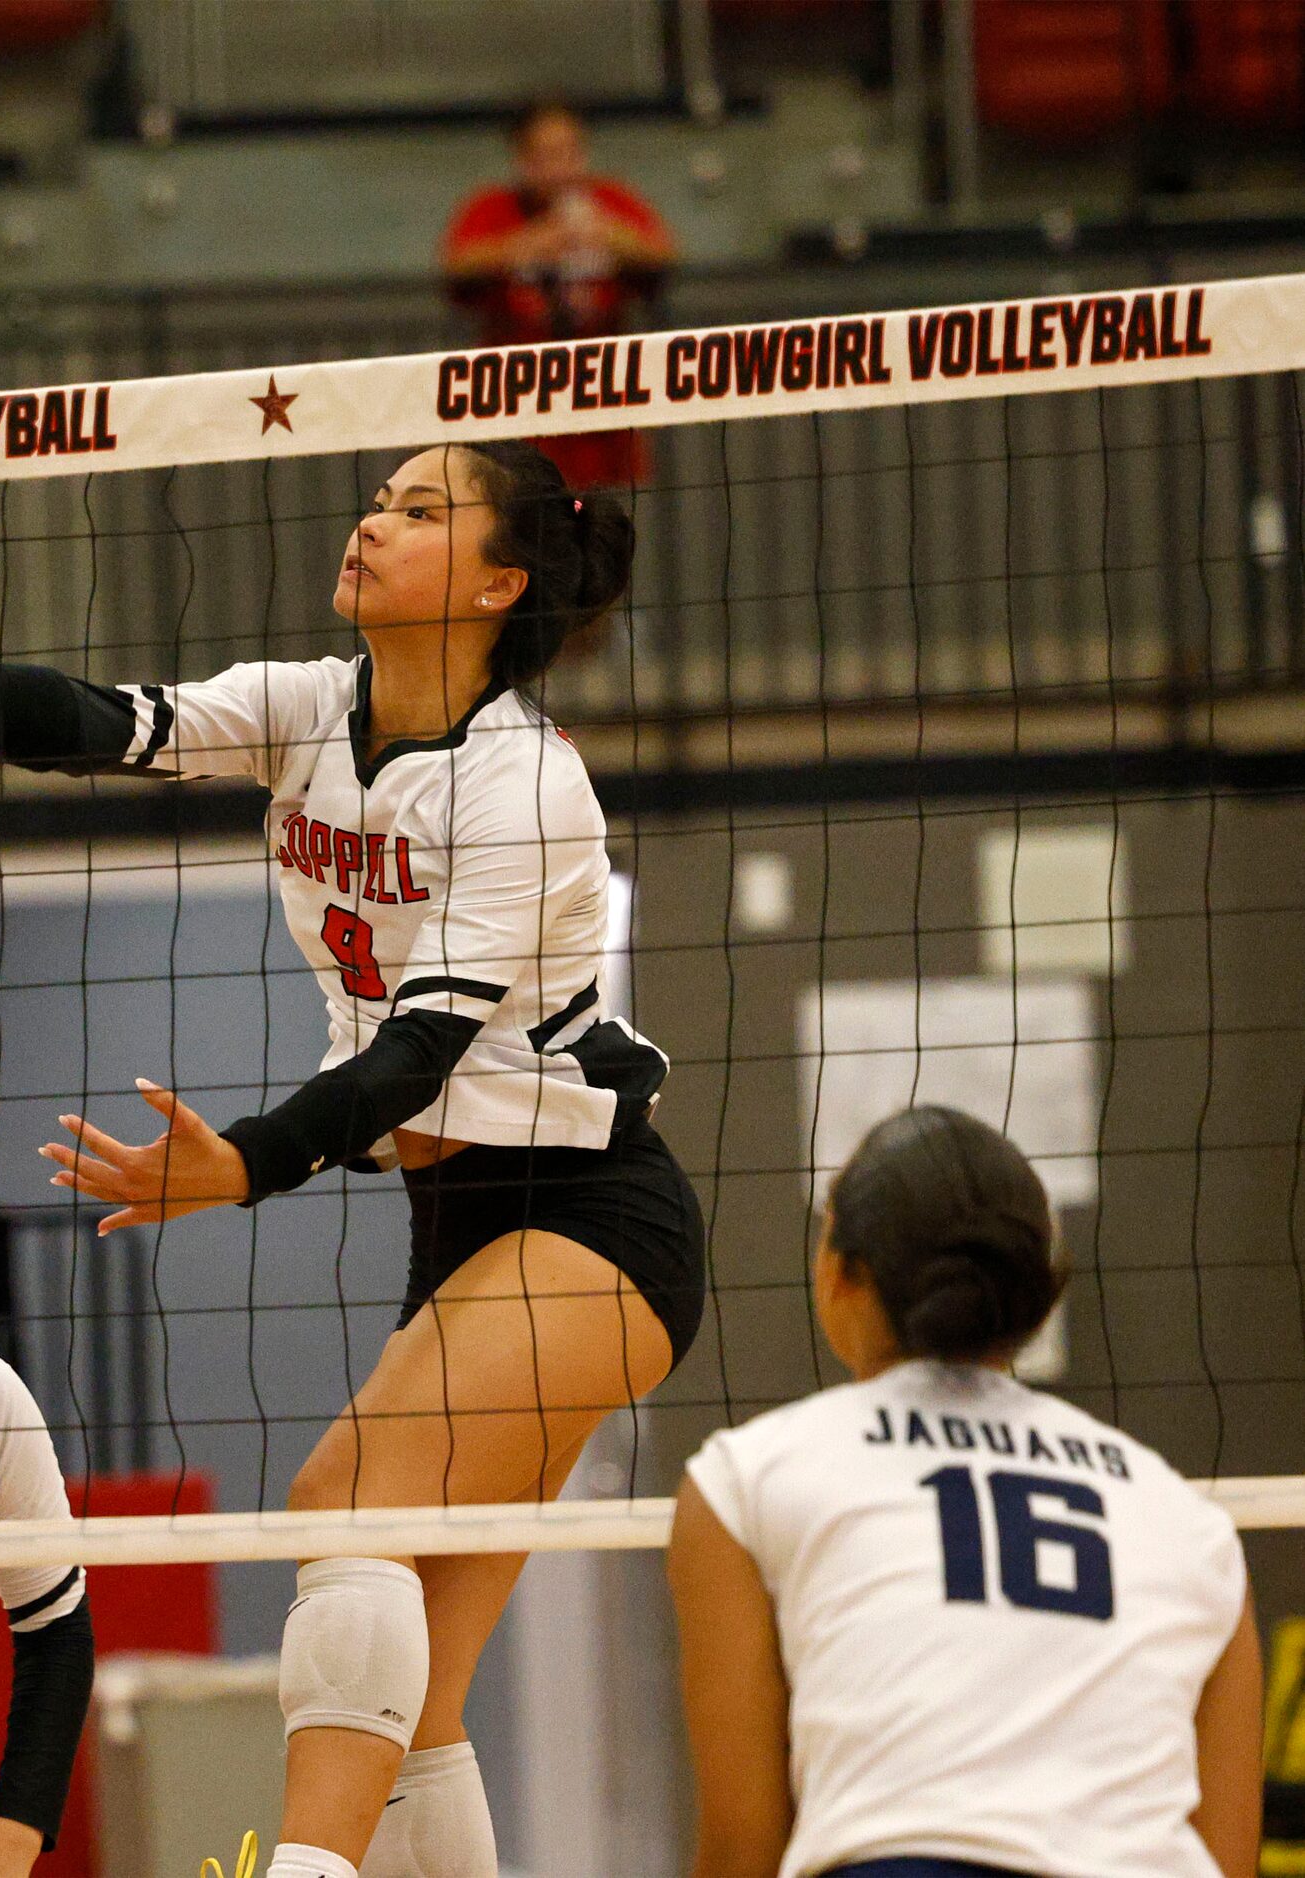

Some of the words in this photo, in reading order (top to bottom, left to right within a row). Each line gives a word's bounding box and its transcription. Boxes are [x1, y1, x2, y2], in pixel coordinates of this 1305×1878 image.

[437, 339, 651, 421] COPPELL
[665, 318, 891, 402] COWGIRL
[908, 288, 1212, 382] VOLLEYBALL
[321, 902, 388, 1002] 9
[865, 1406, 1132, 1482] JAGUARS
[919, 1464, 1116, 1622] 16
